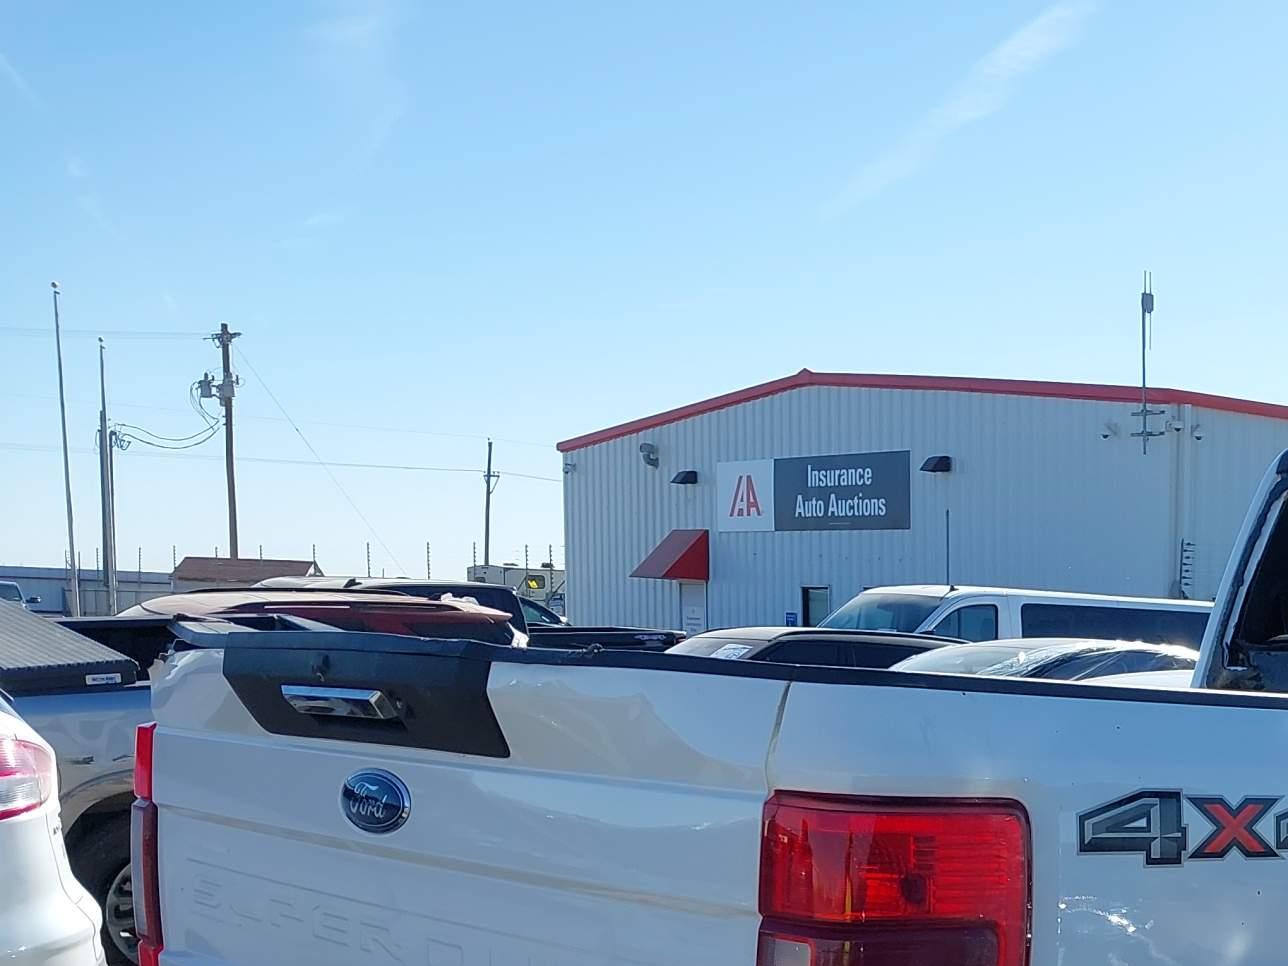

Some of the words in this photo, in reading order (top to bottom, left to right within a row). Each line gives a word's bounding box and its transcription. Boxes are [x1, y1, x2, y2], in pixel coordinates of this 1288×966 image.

[807, 464, 872, 487] Insurance
[795, 494, 824, 517] Auto
[828, 492, 886, 516] Auctions
[349, 781, 388, 818] Ford
